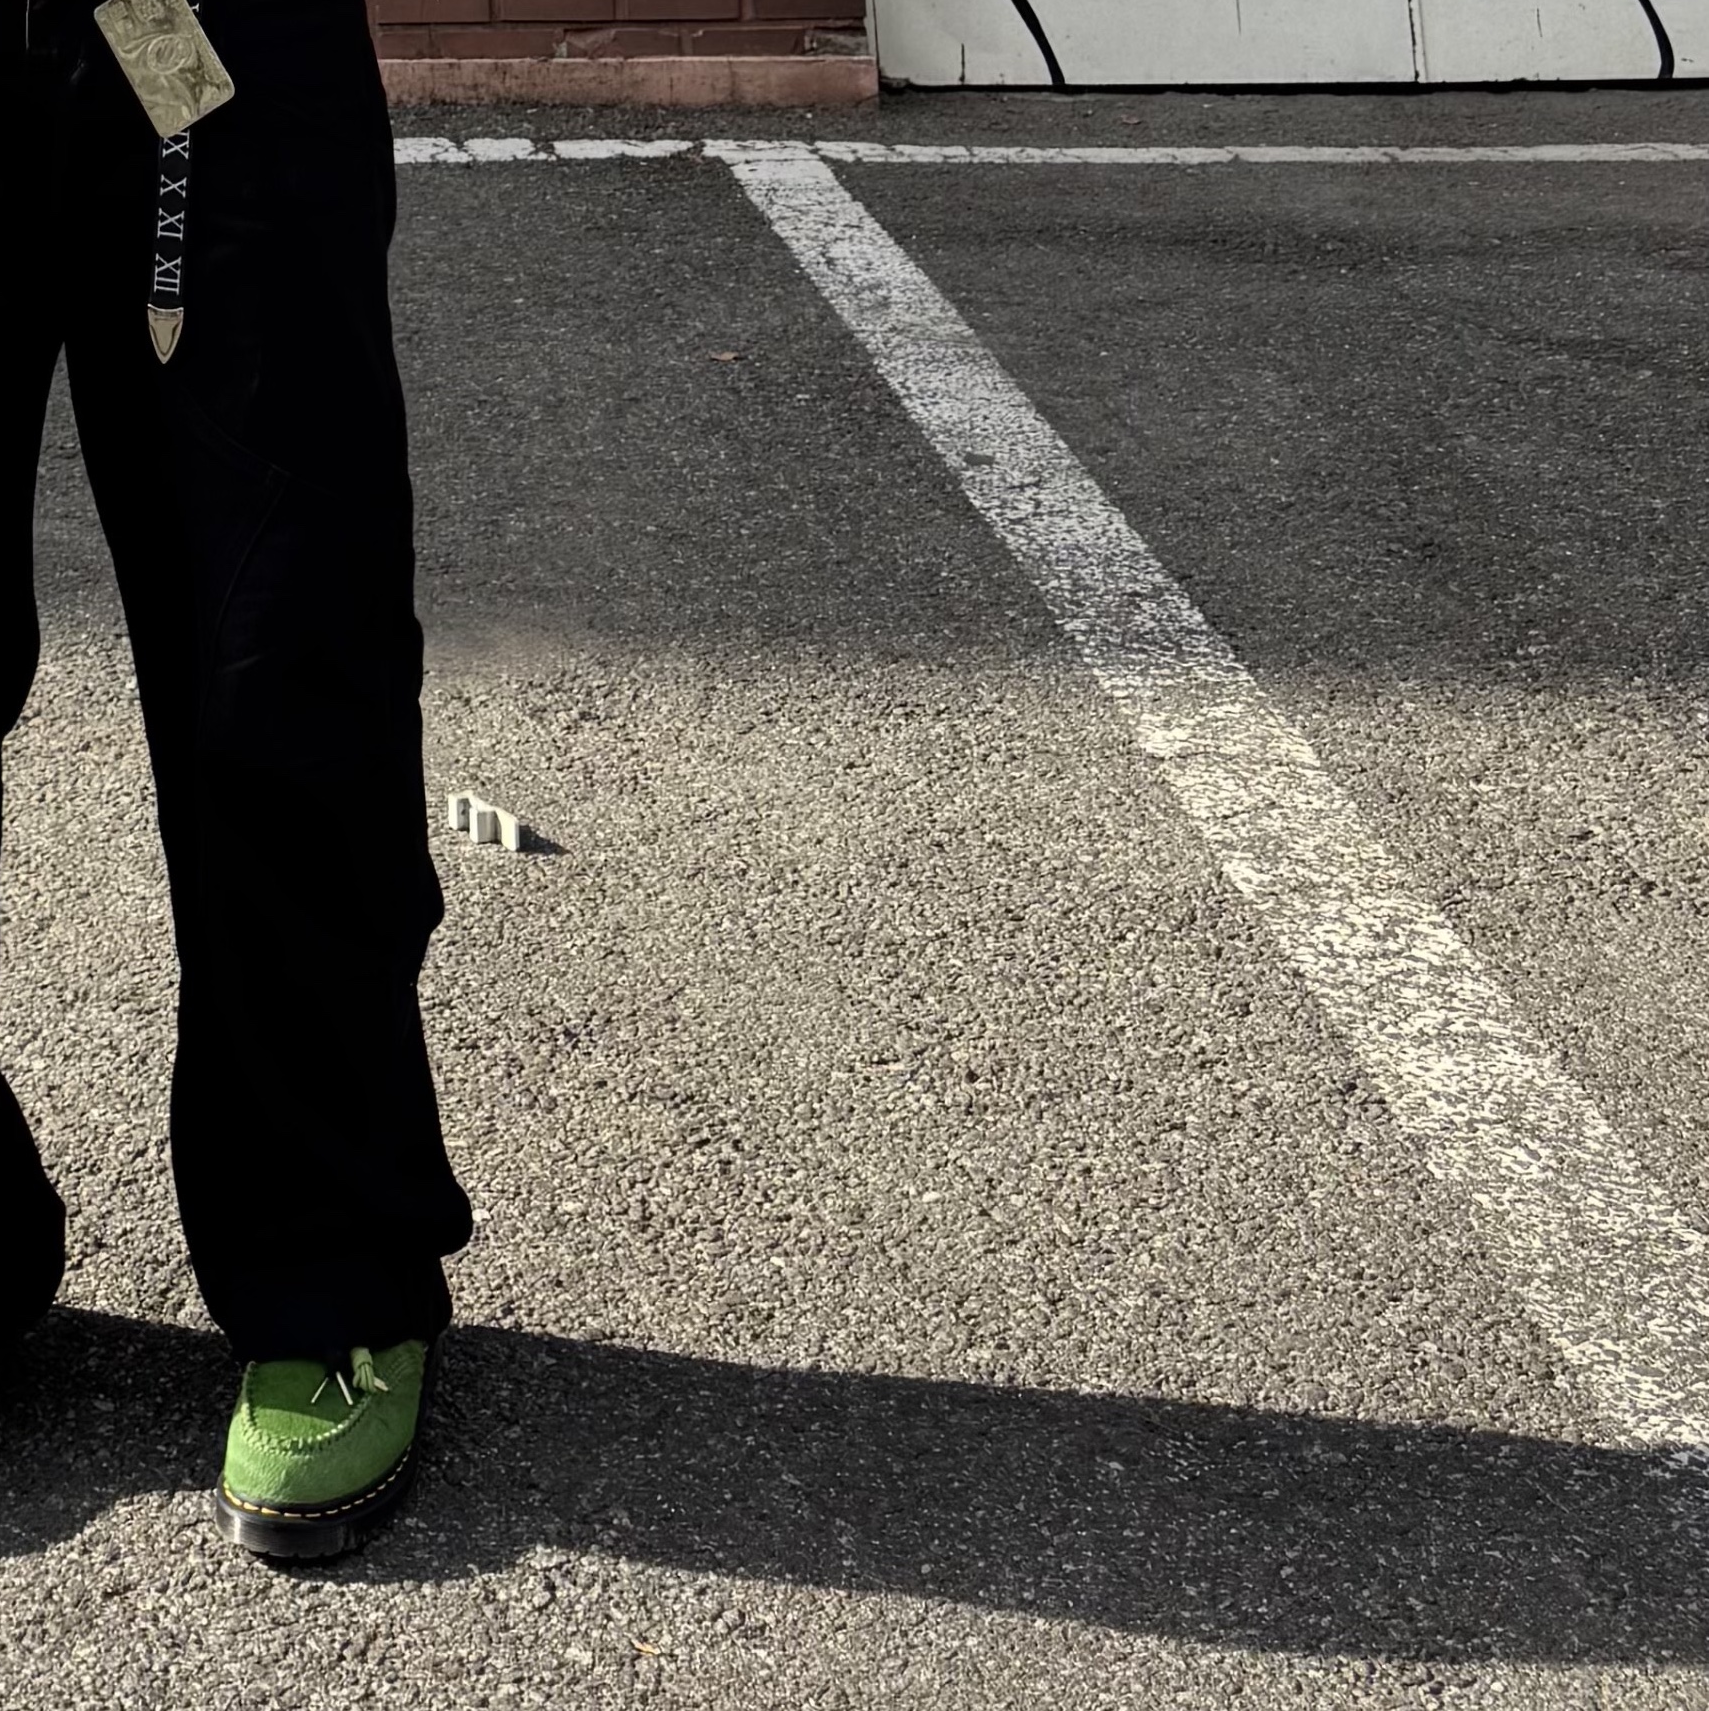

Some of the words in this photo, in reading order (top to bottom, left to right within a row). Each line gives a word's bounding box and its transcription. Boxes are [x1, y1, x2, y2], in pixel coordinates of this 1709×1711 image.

[159, 174, 187, 198] X
[157, 207, 185, 241] XI
[153, 252, 182, 296] XII
